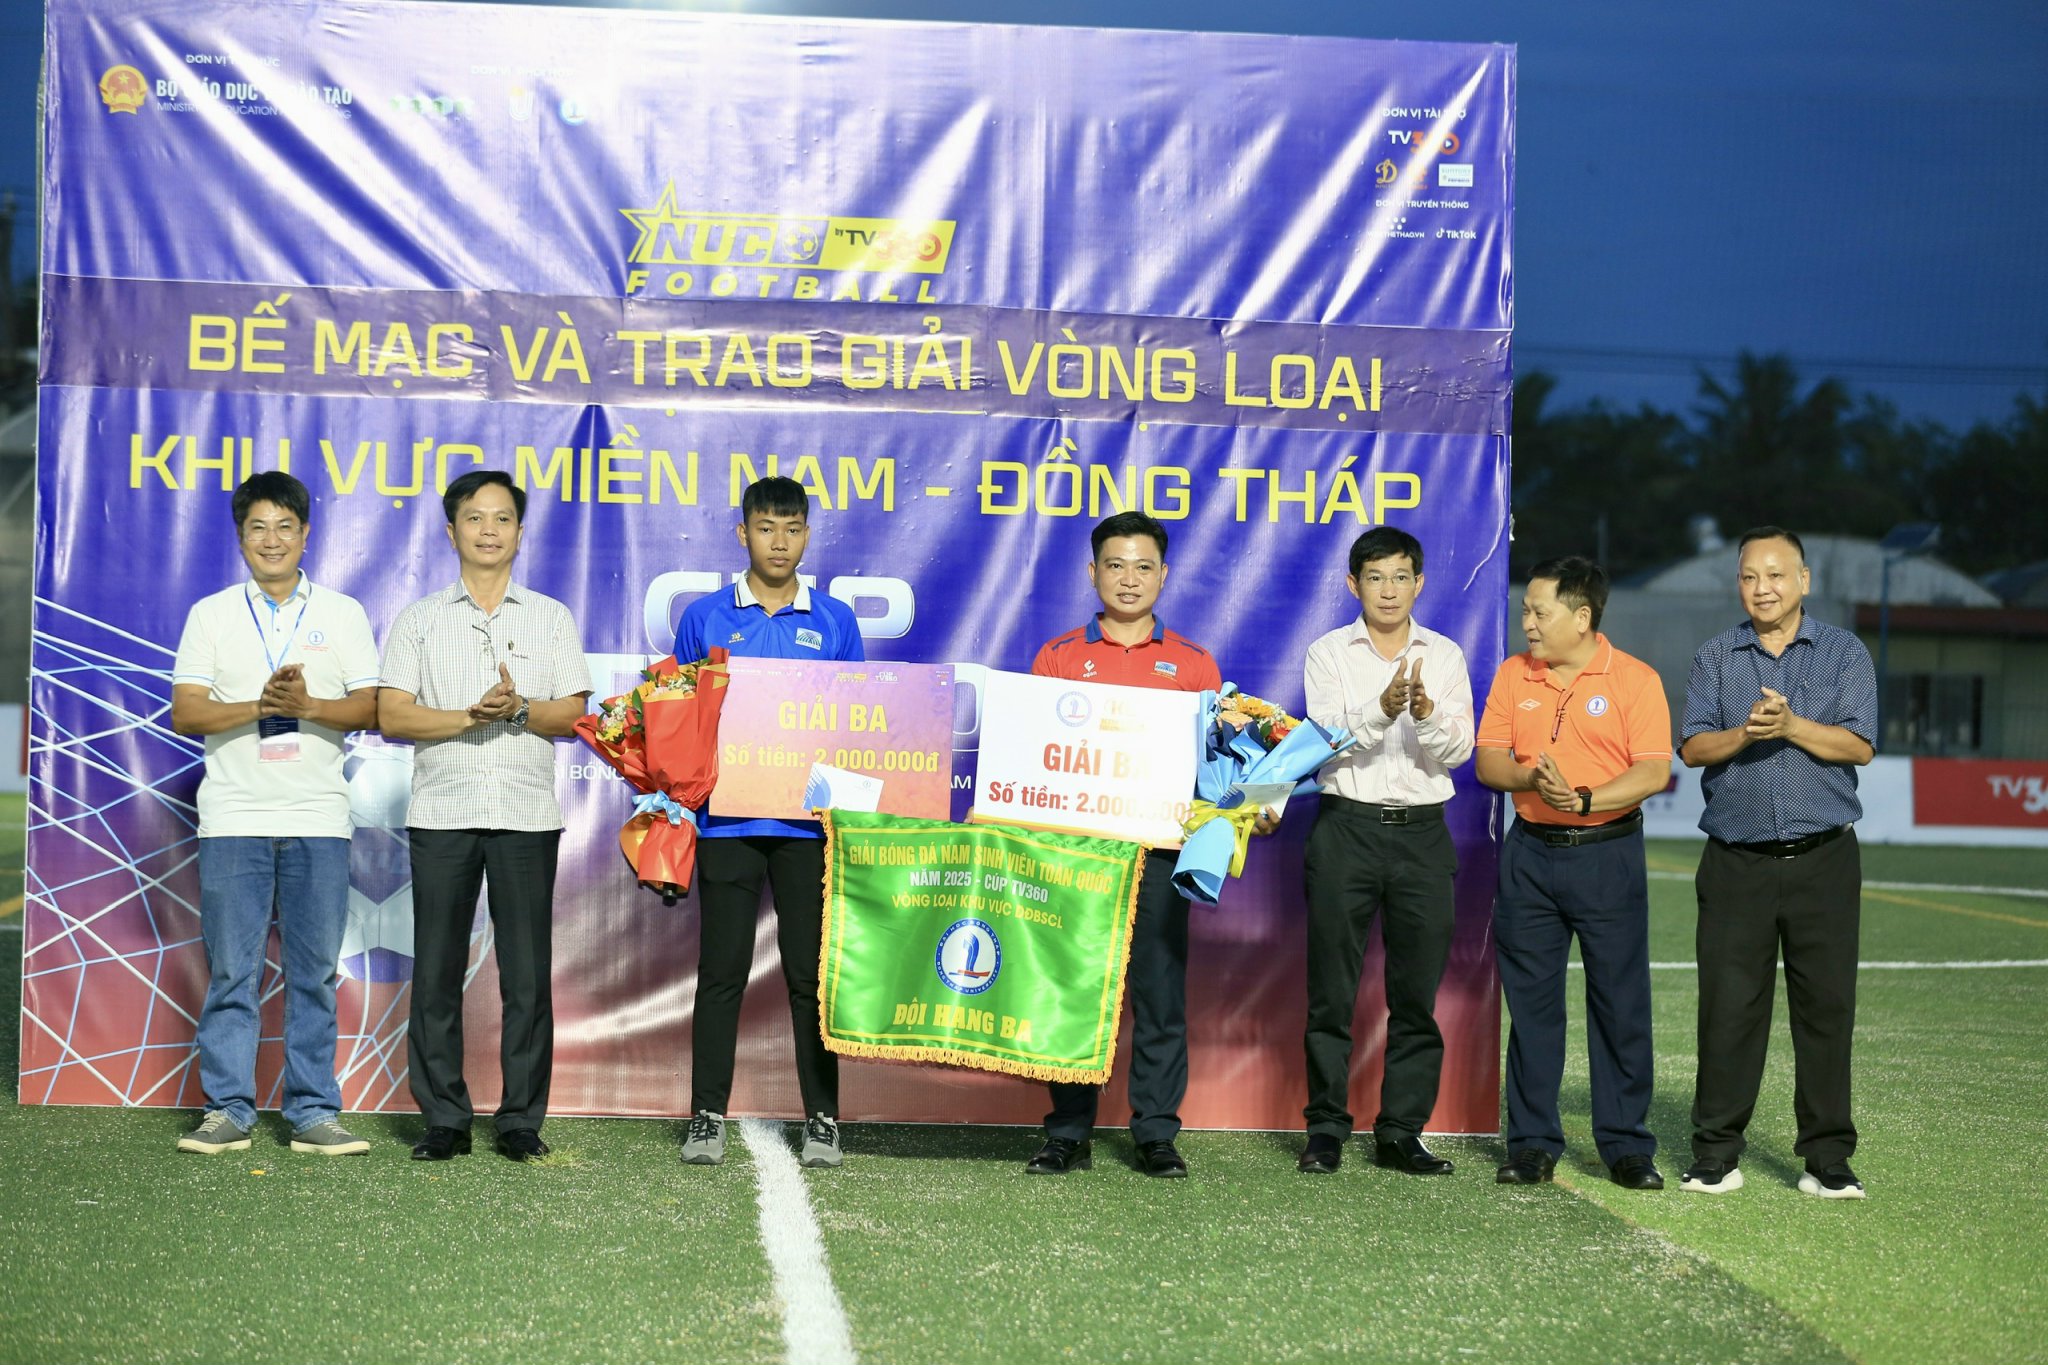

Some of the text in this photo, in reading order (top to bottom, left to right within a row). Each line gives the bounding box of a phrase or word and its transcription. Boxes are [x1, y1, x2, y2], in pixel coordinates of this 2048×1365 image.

[226, 82, 259, 104] DỤC
[323, 86, 353, 108] TẠO
[1410, 108, 1421, 120] VỊ
[1424, 107, 1441, 119] TÀI
[1446, 229, 1477, 240] TikTok
[626, 270, 938, 304] FOOTBALL
[189, 293, 1383, 422] BẾ MẠC VÀ TRAO GIẢI VÒNG LOẠI
[515, 424, 698, 506] MIỀN
[729, 453, 896, 512] NAM
[925, 486, 951, 496] -
[976, 438, 1192, 521] ĐỒNG
[1218, 454, 1422, 526] THÁP
[778, 695, 888, 732] GIẢI BA
[723, 743, 940, 773] Số tiền: 2.000.000đ
[1043, 739, 1101, 776] GIẢI
[988, 780, 1018, 803] Số
[1021, 785, 1069, 810] tiền:
[850, 840, 1113, 894] GIẢI BÓNG ĐÁ NAM SINH VIÊN TOÀN QUỐC
[910, 870, 941, 887] NĂM
[944, 871, 972, 887] 2025
[984, 871, 1008, 892] CÚP
[1011, 879, 1049, 903] TV360
[959, 895, 985, 912] KHU
[893, 996, 1033, 1043] ĐỘI HẠNG BA
